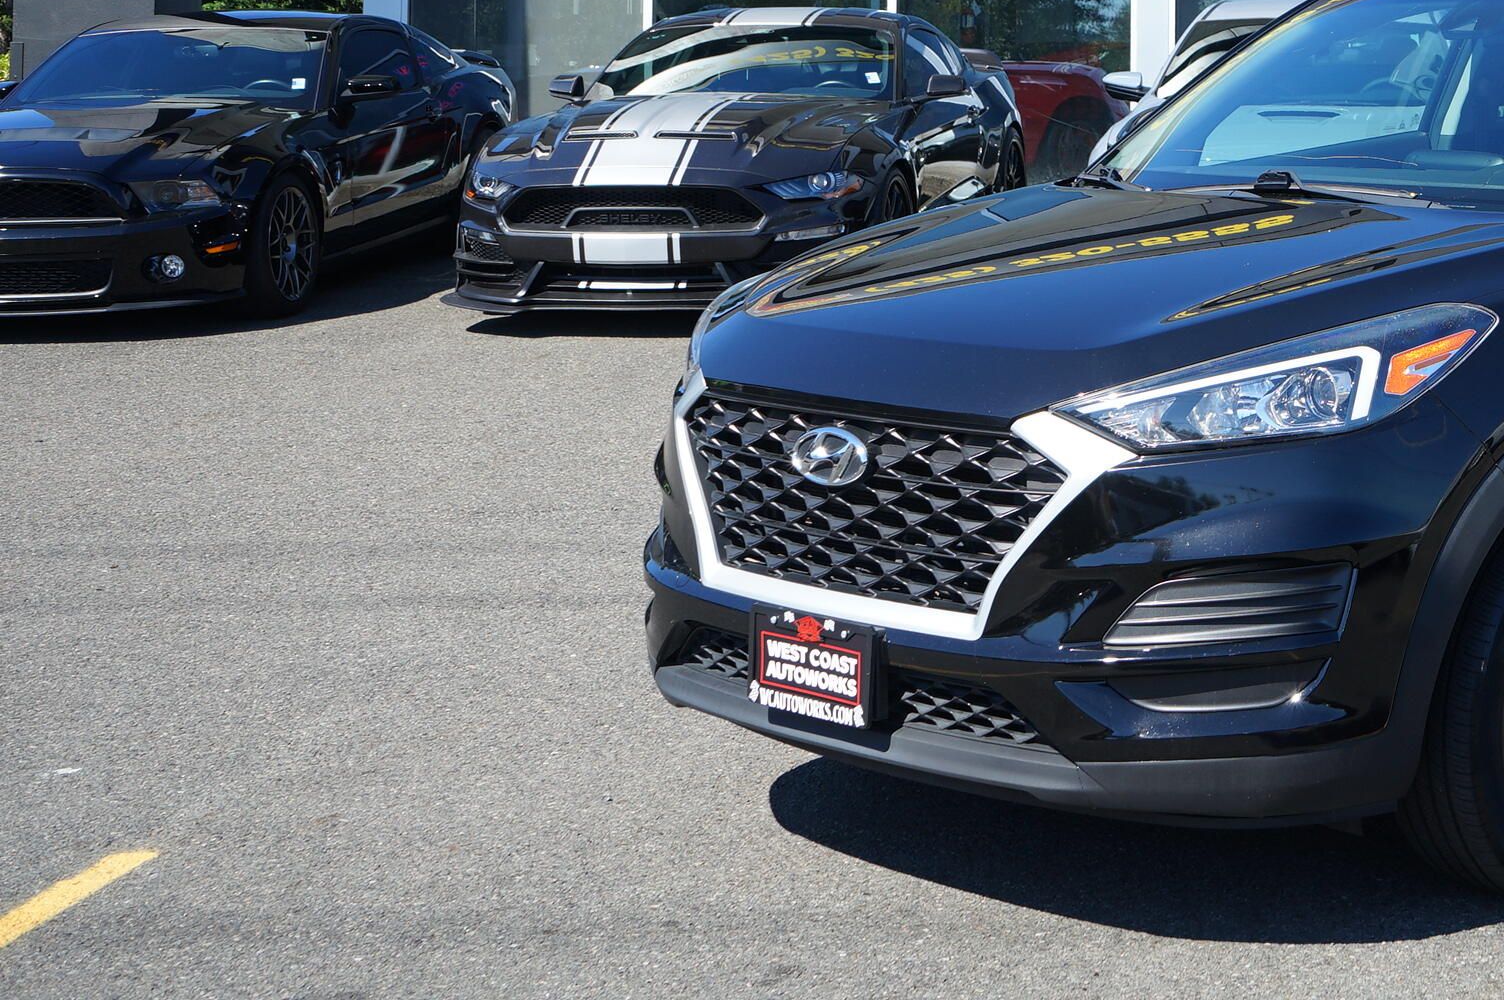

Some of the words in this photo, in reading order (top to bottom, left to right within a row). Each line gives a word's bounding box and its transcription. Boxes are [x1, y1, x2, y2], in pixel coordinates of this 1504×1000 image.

[600, 213, 661, 225] SHELBY
[766, 639, 809, 667] WEST
[809, 648, 858, 676] COAST
[765, 660, 858, 698] AUTOWORKS
[759, 686, 855, 727] WCAUTOWORKS.COM
